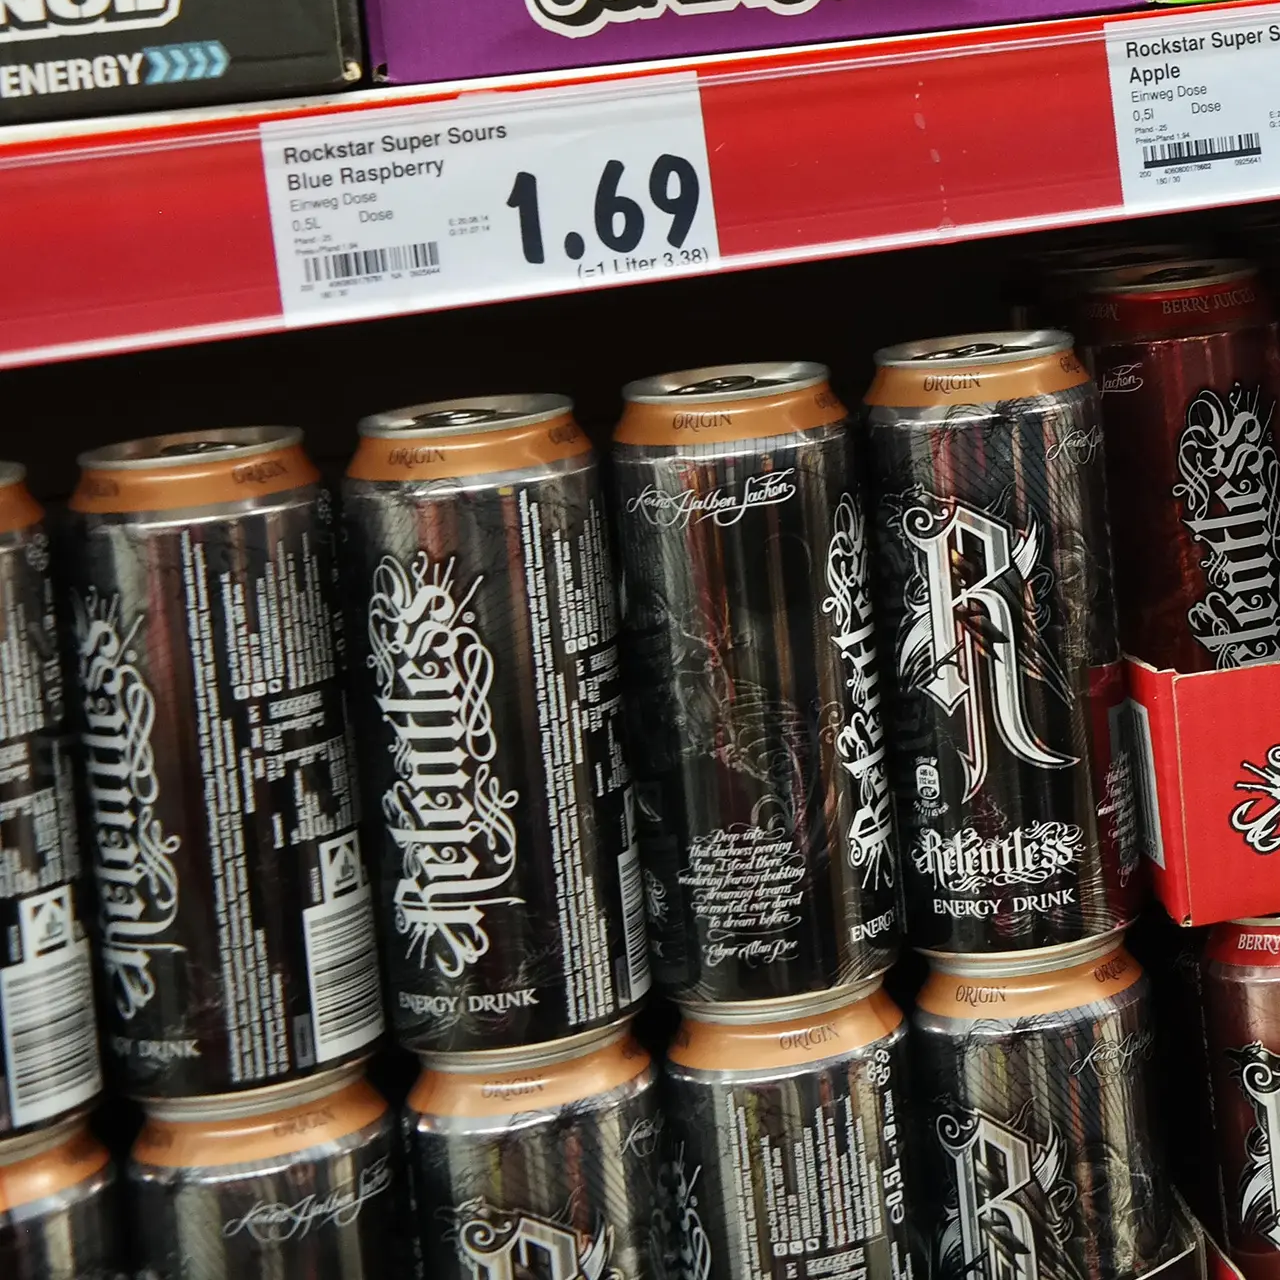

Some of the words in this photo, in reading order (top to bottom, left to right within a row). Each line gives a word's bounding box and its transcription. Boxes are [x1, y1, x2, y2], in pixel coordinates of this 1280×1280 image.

[1126, 34, 1205, 58] Rockstar
[1211, 29, 1264, 50] Super
[1129, 64, 1181, 85] Apple
[1131, 88, 1174, 104] Einweg
[1178, 83, 1208, 98] Dose
[1191, 100, 1221, 115] Dose
[284, 139, 375, 164] Rockstar
[381, 131, 441, 154] Super
[447, 124, 507, 144] Sours
[287, 171, 333, 191] Blue
[340, 159, 445, 185] Raspberry
[342, 191, 377, 205] Dose
[506, 153, 700, 265] 1.69
[614, 256, 657, 275] Liter
[663, 248, 709, 268] 3.38)
[923, 372, 982, 393] ORIGIN
[672, 410, 733, 432] ORIGIN
[933, 895, 1006, 918] ENERGY
[1013, 888, 1076, 911] DRINK
